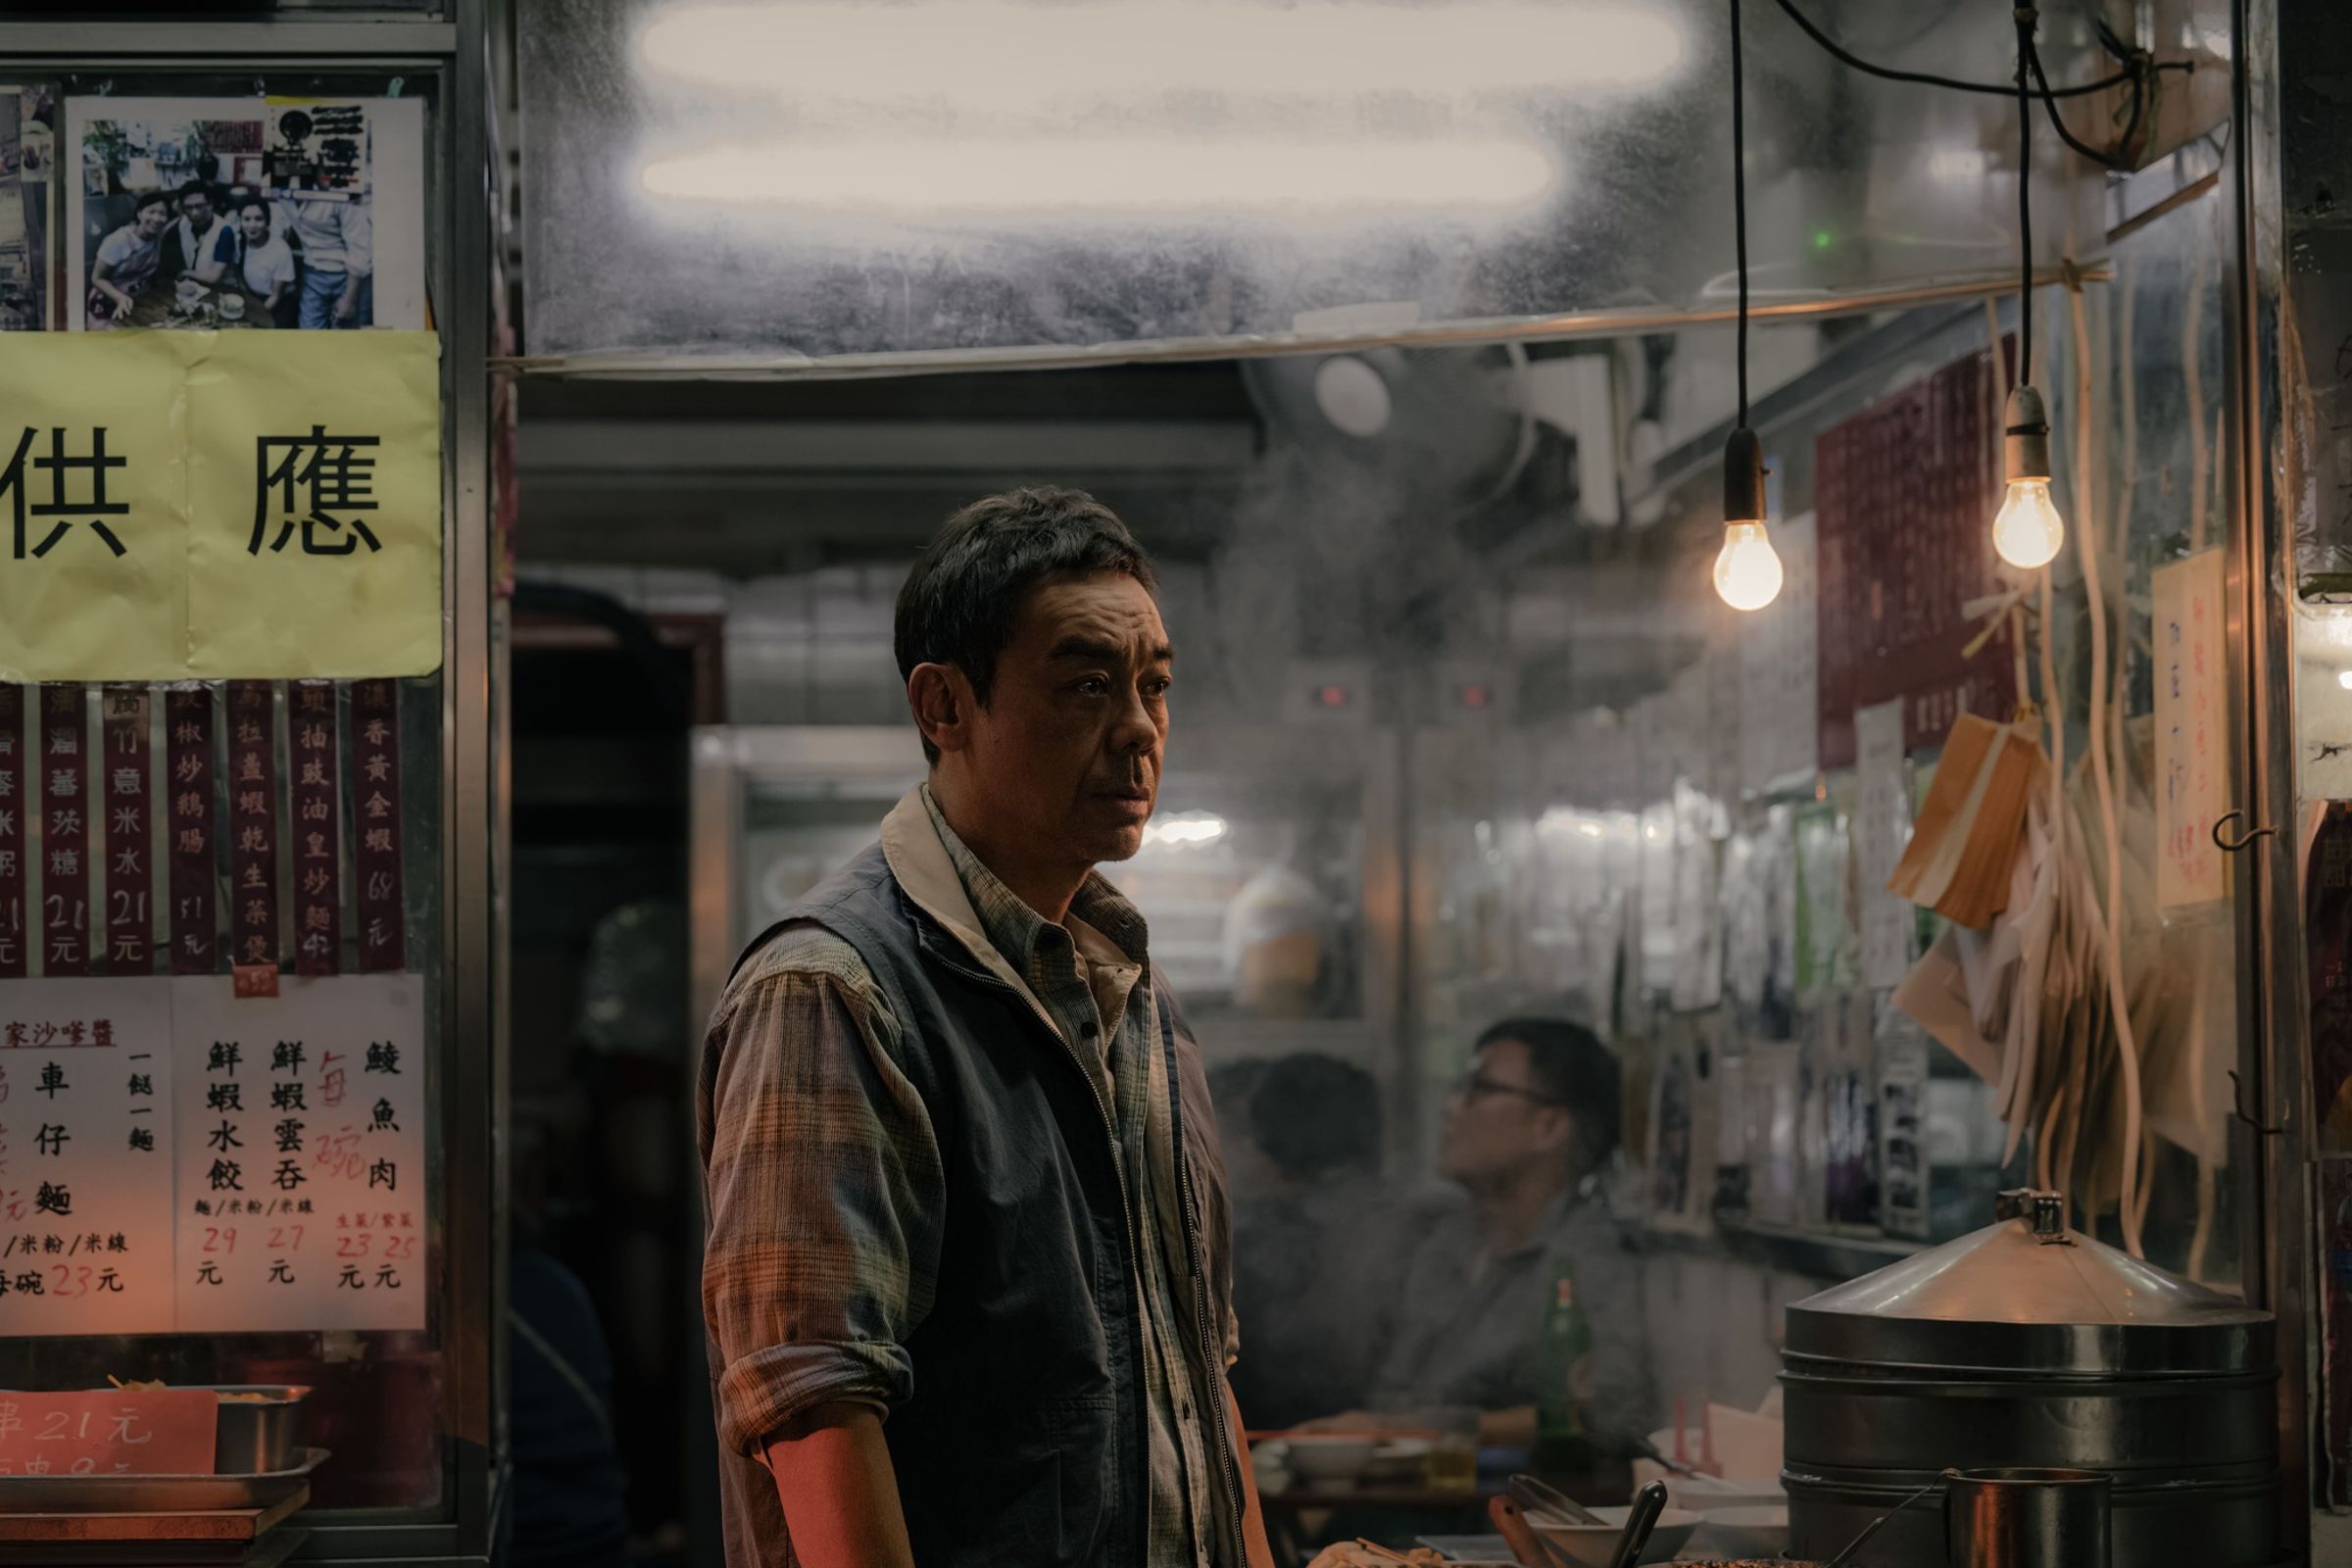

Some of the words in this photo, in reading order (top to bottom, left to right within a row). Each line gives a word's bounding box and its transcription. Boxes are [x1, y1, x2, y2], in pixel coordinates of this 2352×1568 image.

[0, 425, 381, 559] 供應
[207, 1041, 244, 1191] 鮮蝦水餃
[270, 1041, 308, 1191] 鮮蝦雲吞
[365, 1041, 402, 1191] 鯪魚肉
[34, 1061, 73, 1215] 車仔麵
[203, 1226, 236, 1254] 29
[267, 1225, 304, 1251] 27
[336, 1234, 371, 1257] 23
[195, 1260, 223, 1285] 元
[268, 1259, 295, 1284] 元
[337, 1264, 365, 1289] 元
[373, 1264, 401, 1289] 元
